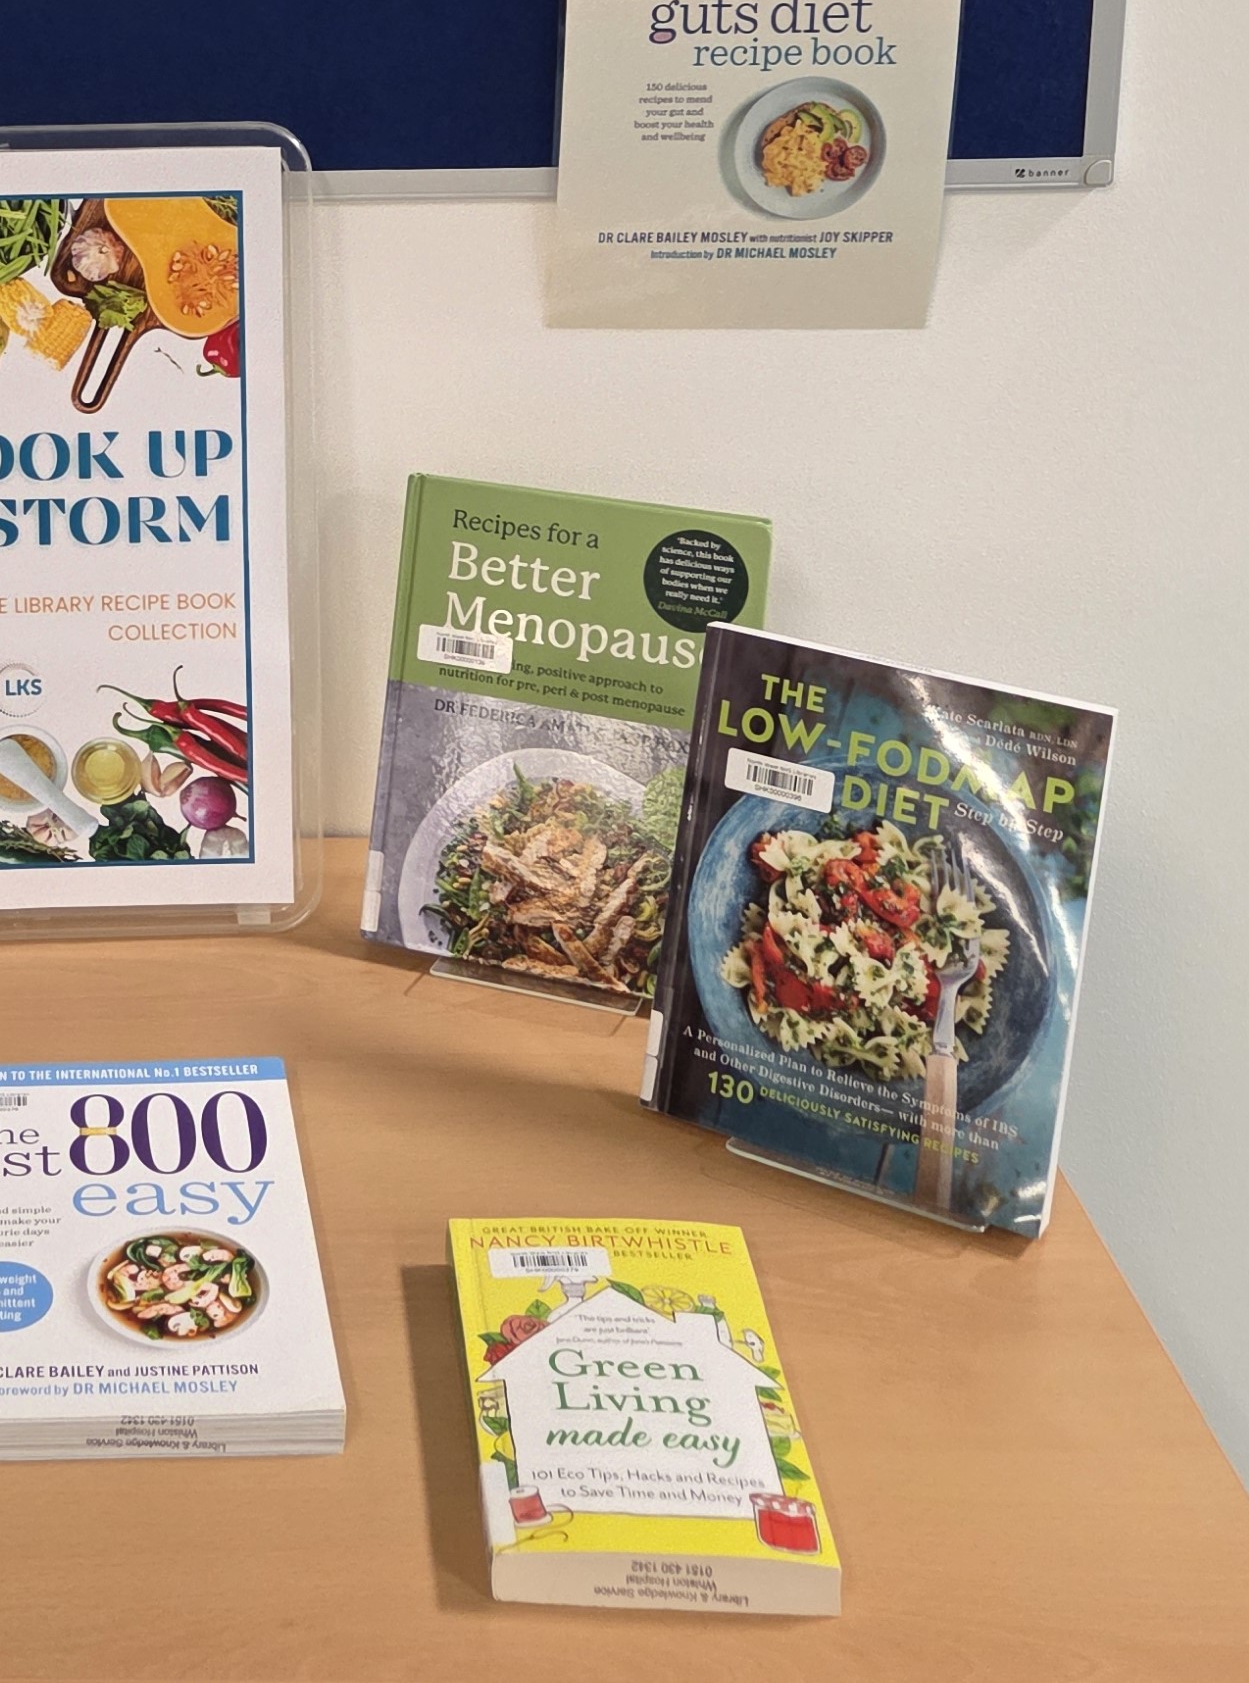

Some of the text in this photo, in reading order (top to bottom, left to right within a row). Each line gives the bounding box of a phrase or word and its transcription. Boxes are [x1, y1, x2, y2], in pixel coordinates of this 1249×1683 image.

[692, 37, 897, 71] recipe book
[1028, 169, 1069, 178] banner
[147, 429, 234, 480] UP
[453, 509, 599, 549] Recipes for a
[449, 541, 601, 600] Better
[14, 594, 94, 614] LIBRARY
[101, 593, 169, 612] RECIPE
[177, 592, 236, 610] BOOK
[108, 622, 236, 642] COLLECTION
[5, 679, 41, 696] LKS
[761, 673, 827, 714] THE
[842, 776, 950, 830] DIET
[11, 1071, 25, 1080] TO
[30, 1070, 51, 1080] THE
[56, 1067, 150, 1079] INTERNATIONAL
[184, 1065, 258, 1077] BESTSELLER
[69, 1091, 268, 1176] 800
[707, 1070, 979, 1164] 130 DELICIOUSLY SATISFYING RECIPES
[72, 1179, 276, 1224] easy
[470, 1234, 732, 1255] NANCY BIRTWHISTLE
[548, 1349, 703, 1382] Green
[554, 1381, 711, 1426] Living
[546, 1417, 741, 1468] made easy
